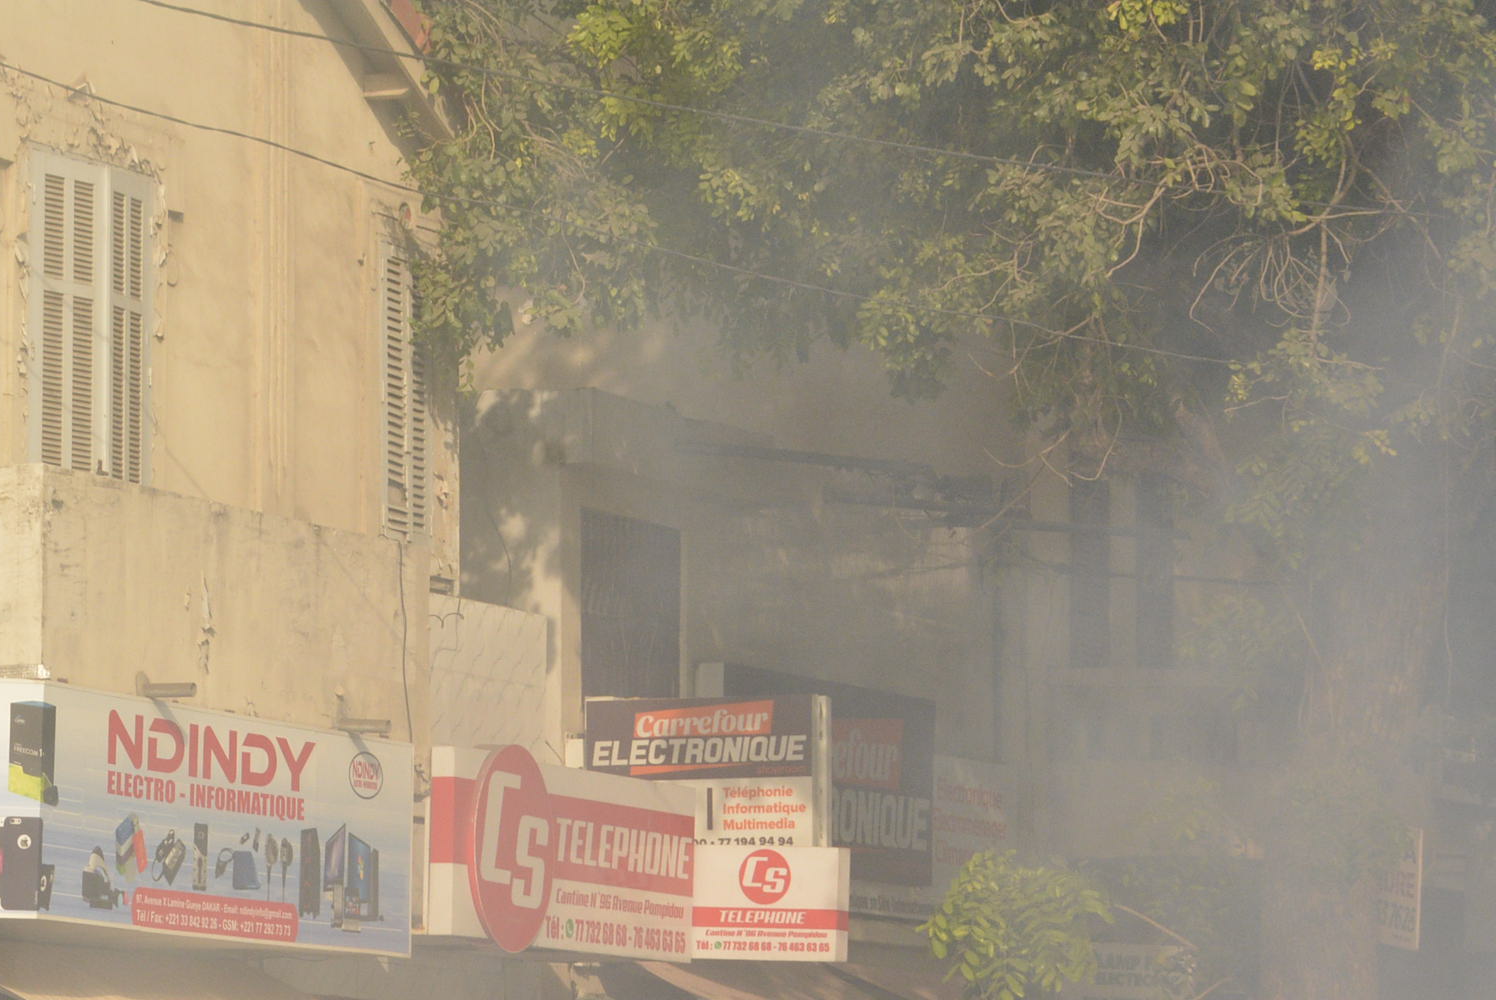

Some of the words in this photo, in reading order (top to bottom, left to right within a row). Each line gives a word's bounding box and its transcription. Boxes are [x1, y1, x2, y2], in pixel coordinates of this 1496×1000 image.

[635, 708, 769, 738] Carrefour
[107, 709, 317, 792] NDINDY
[592, 734, 807, 767] ELECTRONIQUE
[107, 771, 176, 804] ELECTRO
[189, 783, 305, 821] INFORMATIQUE
[723, 786, 794, 799] Téléphonie
[723, 803, 807, 817] Informatique
[723, 818, 796, 831] Multimedia
[555, 816, 693, 880] TELEPHONE
[759, 836, 774, 846] 94
[778, 836, 794, 846] 94
[555, 887, 589, 907] Cantine
[612, 895, 643, 914] Avenue
[643, 899, 685, 919] Pompidou
[718, 909, 807, 924] TELEPHONE
